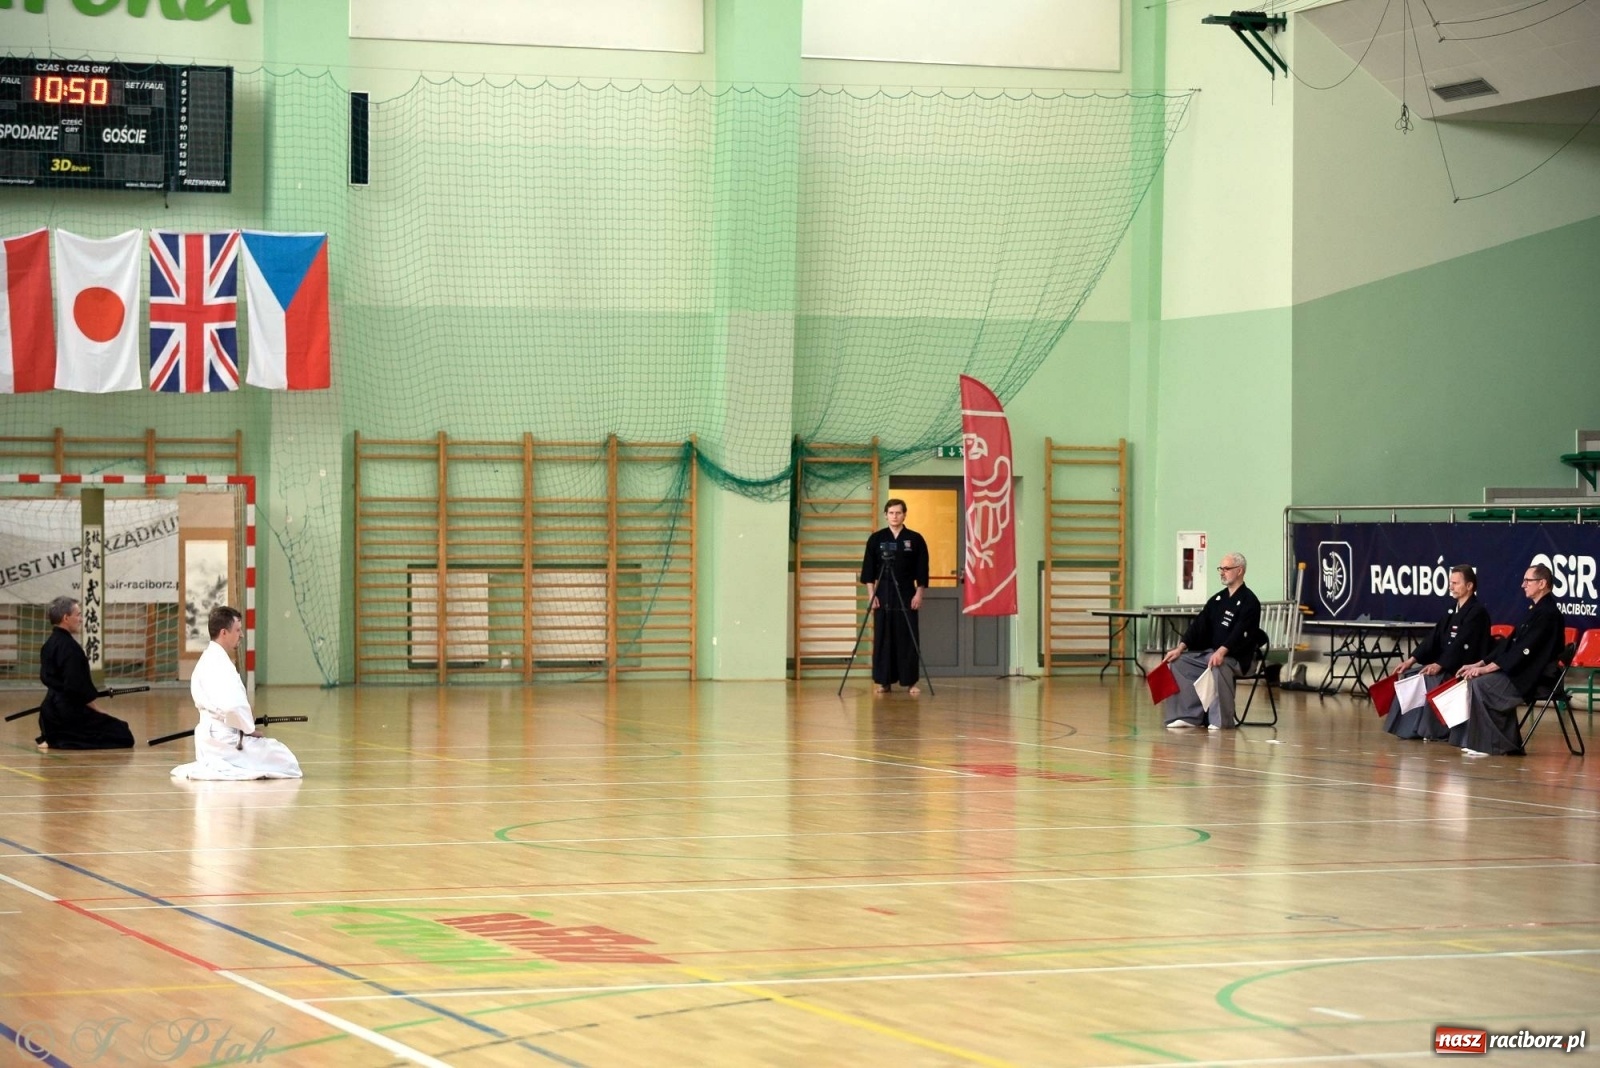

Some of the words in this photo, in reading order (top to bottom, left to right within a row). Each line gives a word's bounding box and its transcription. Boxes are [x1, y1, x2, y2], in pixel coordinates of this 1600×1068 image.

[36, 63, 60, 72] CZAS
[66, 64, 90, 73] CZAS
[91, 66, 111, 74] GRY
[34, 76, 108, 105] 10:50
[0, 123, 59, 141] SPODARZE
[102, 124, 147, 144] GOŚCIE
[179, 124, 188, 132] 10
[46, 550, 66, 570] W
[70, 515, 179, 563] PRZĄDKU
[1370, 555, 1477, 597] RACIBÓ
[1556, 600, 1598, 616] RACIBÓRZ
